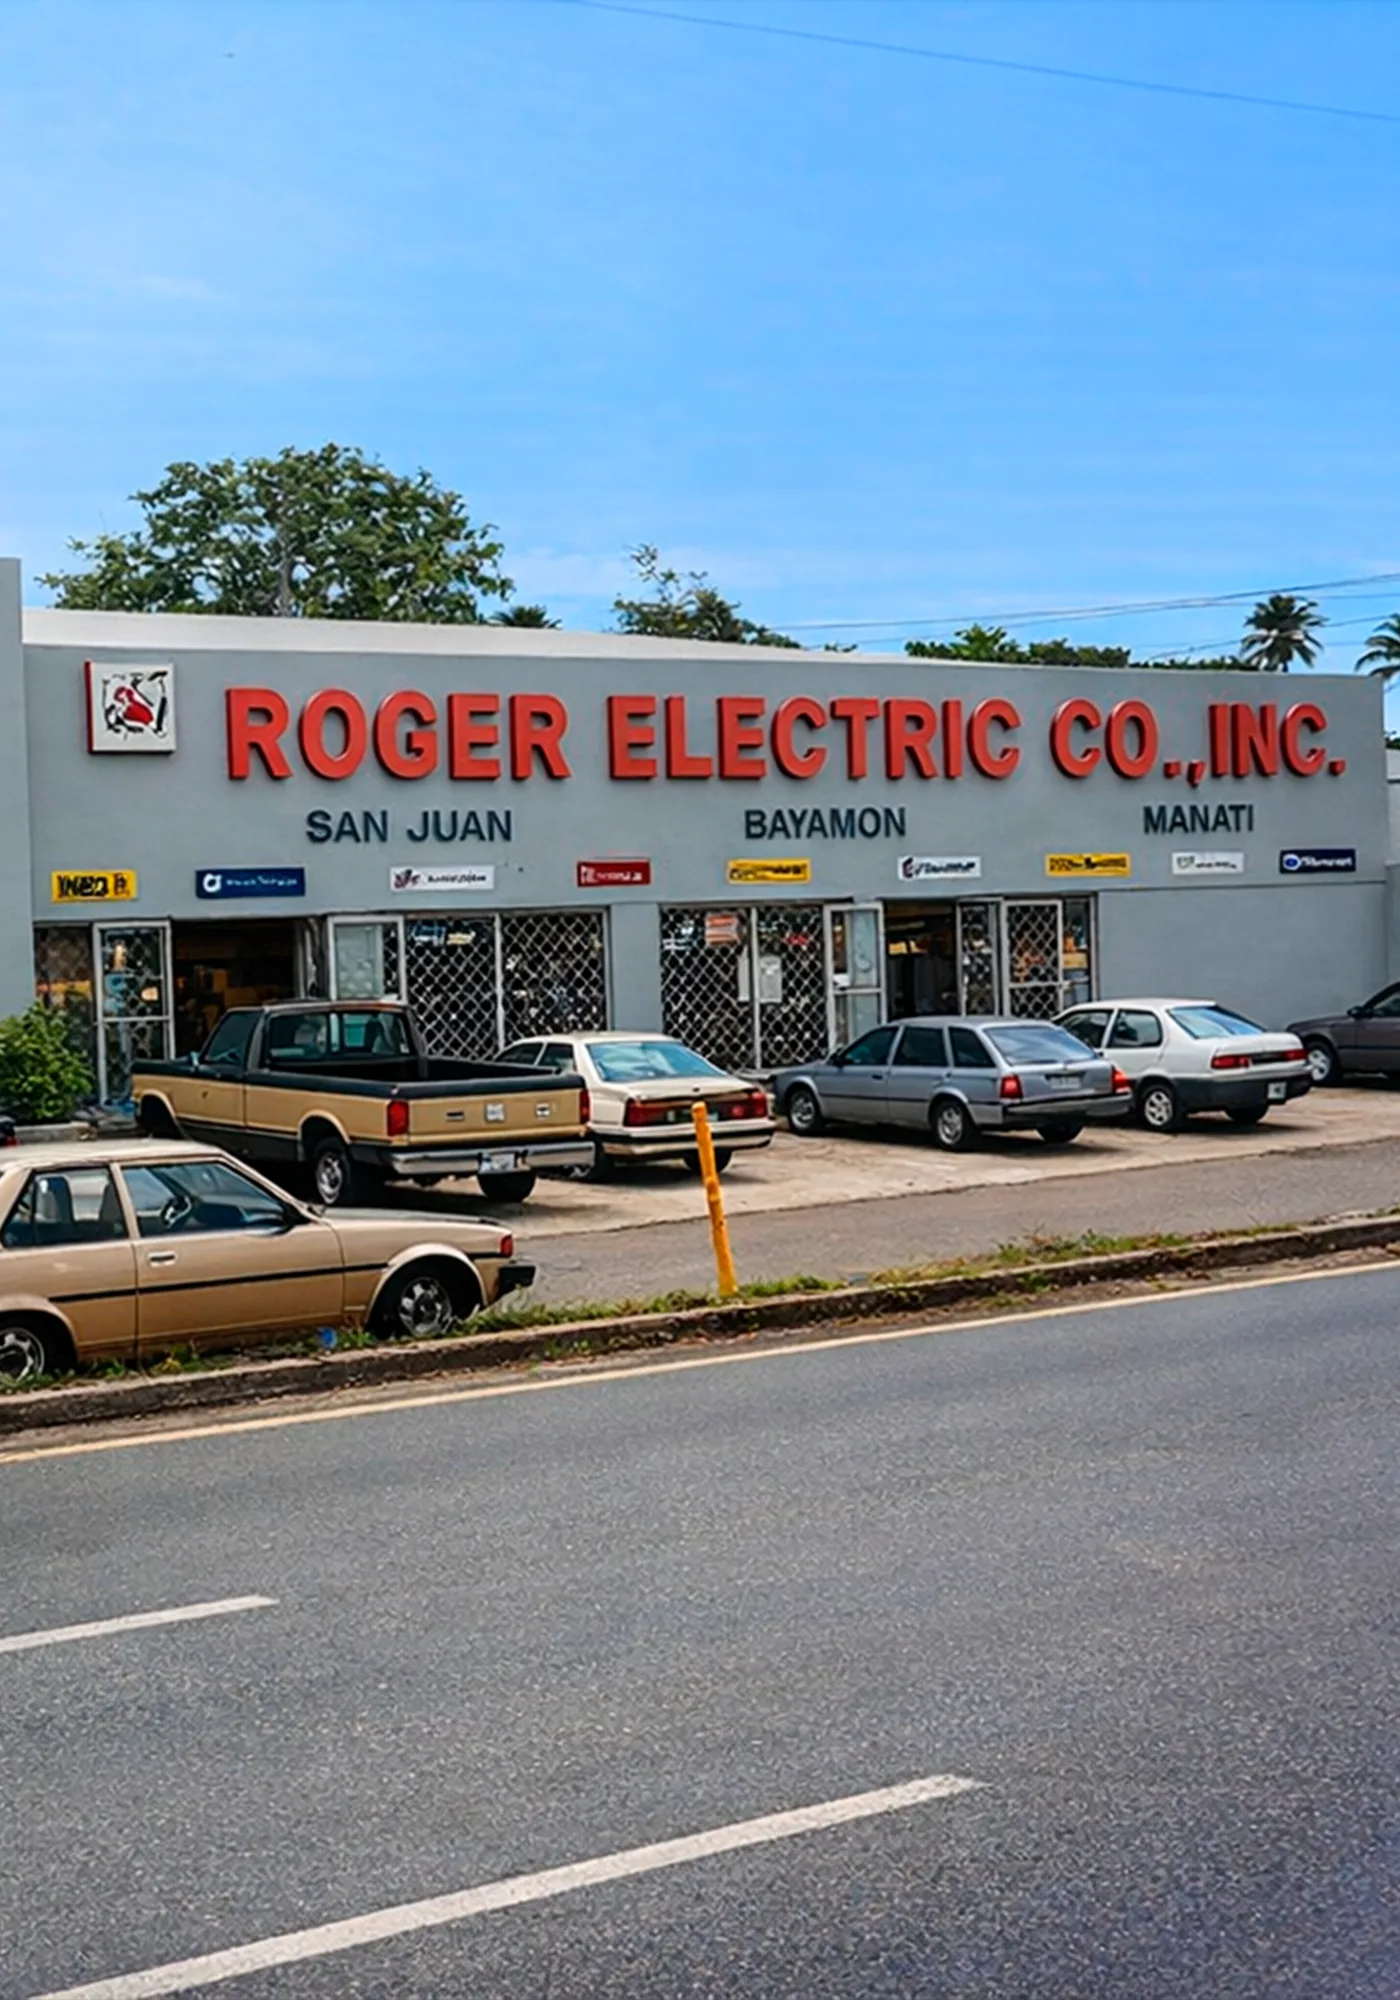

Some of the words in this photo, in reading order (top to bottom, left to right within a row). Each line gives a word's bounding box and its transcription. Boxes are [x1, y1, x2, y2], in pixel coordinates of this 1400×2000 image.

[227, 686, 571, 779] ROGER
[608, 694, 1022, 778] ELECTRIC
[305, 808, 388, 844] SAN
[406, 809, 513, 844] JUAN
[744, 807, 906, 840] BAYAMON
[1143, 803, 1255, 836] MANATI
